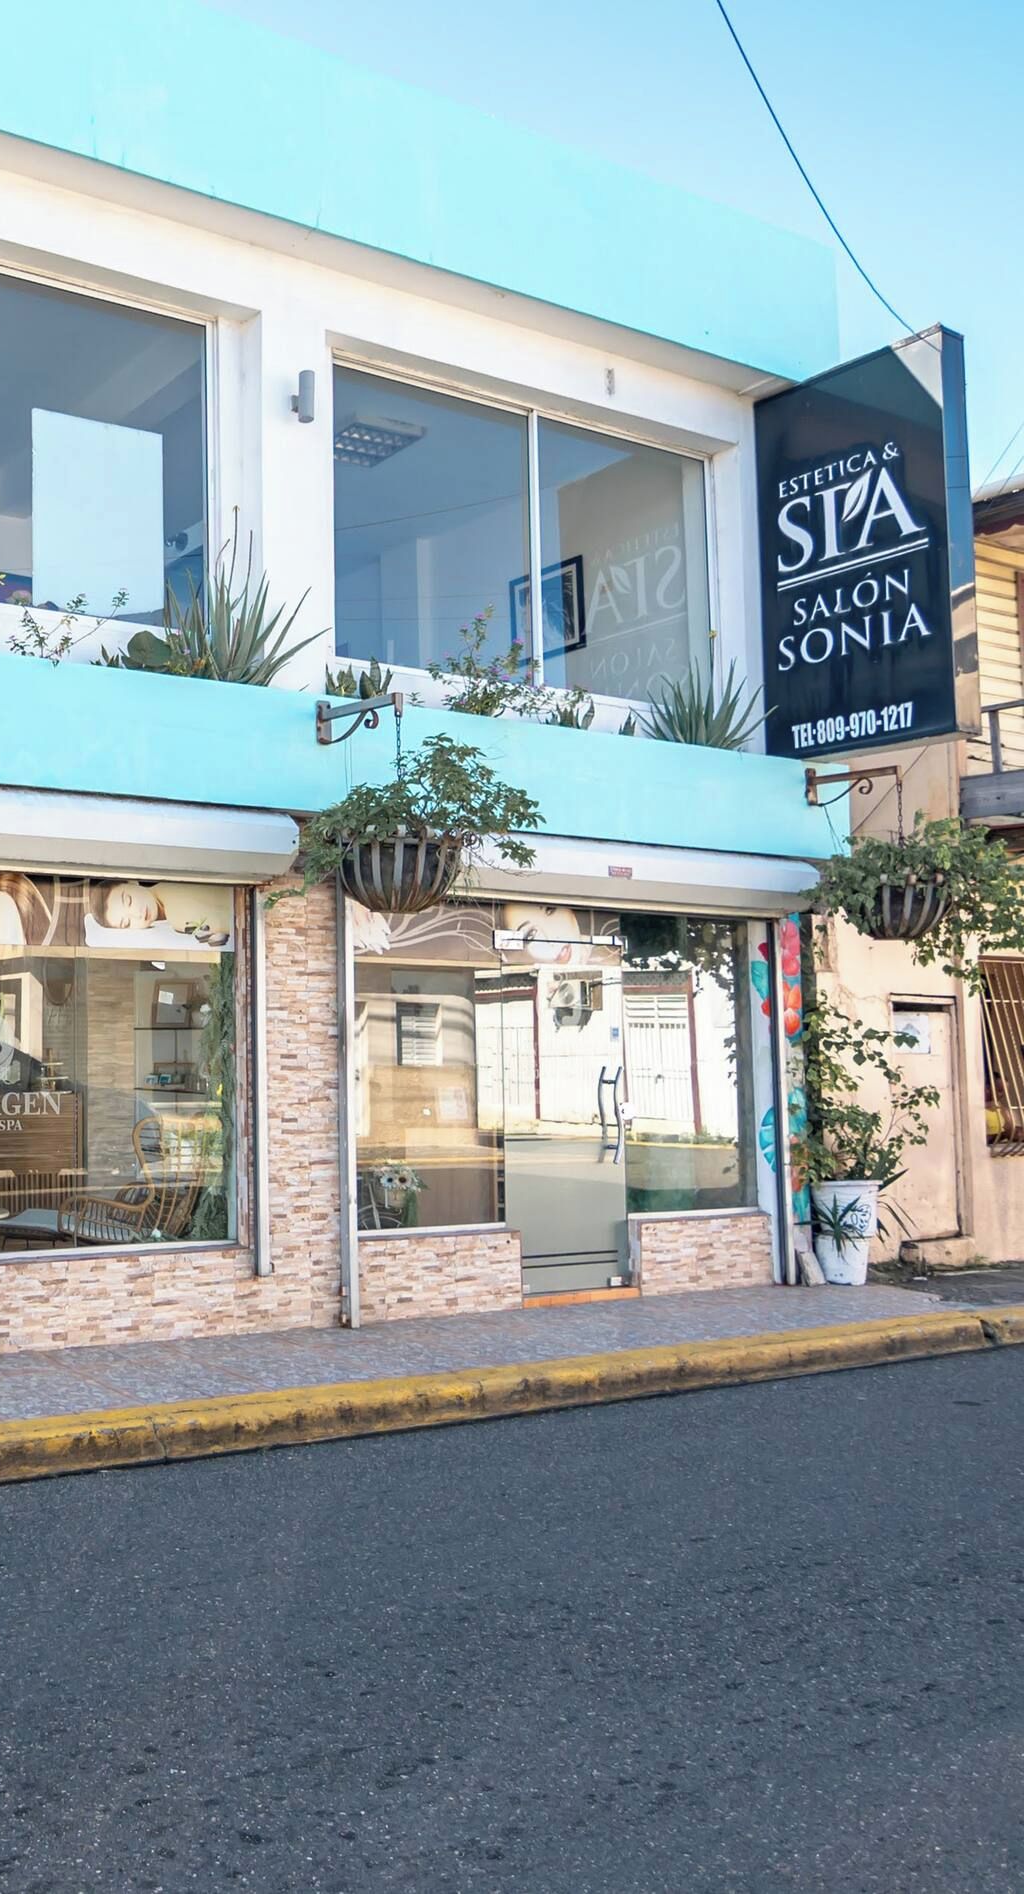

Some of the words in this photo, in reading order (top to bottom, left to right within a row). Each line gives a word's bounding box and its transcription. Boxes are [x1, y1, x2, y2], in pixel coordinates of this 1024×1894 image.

[778, 450, 877, 498] ESTETICA
[882, 441, 900, 461] &
[793, 569, 909, 626] SALÓN
[778, 603, 933, 671] SONIA
